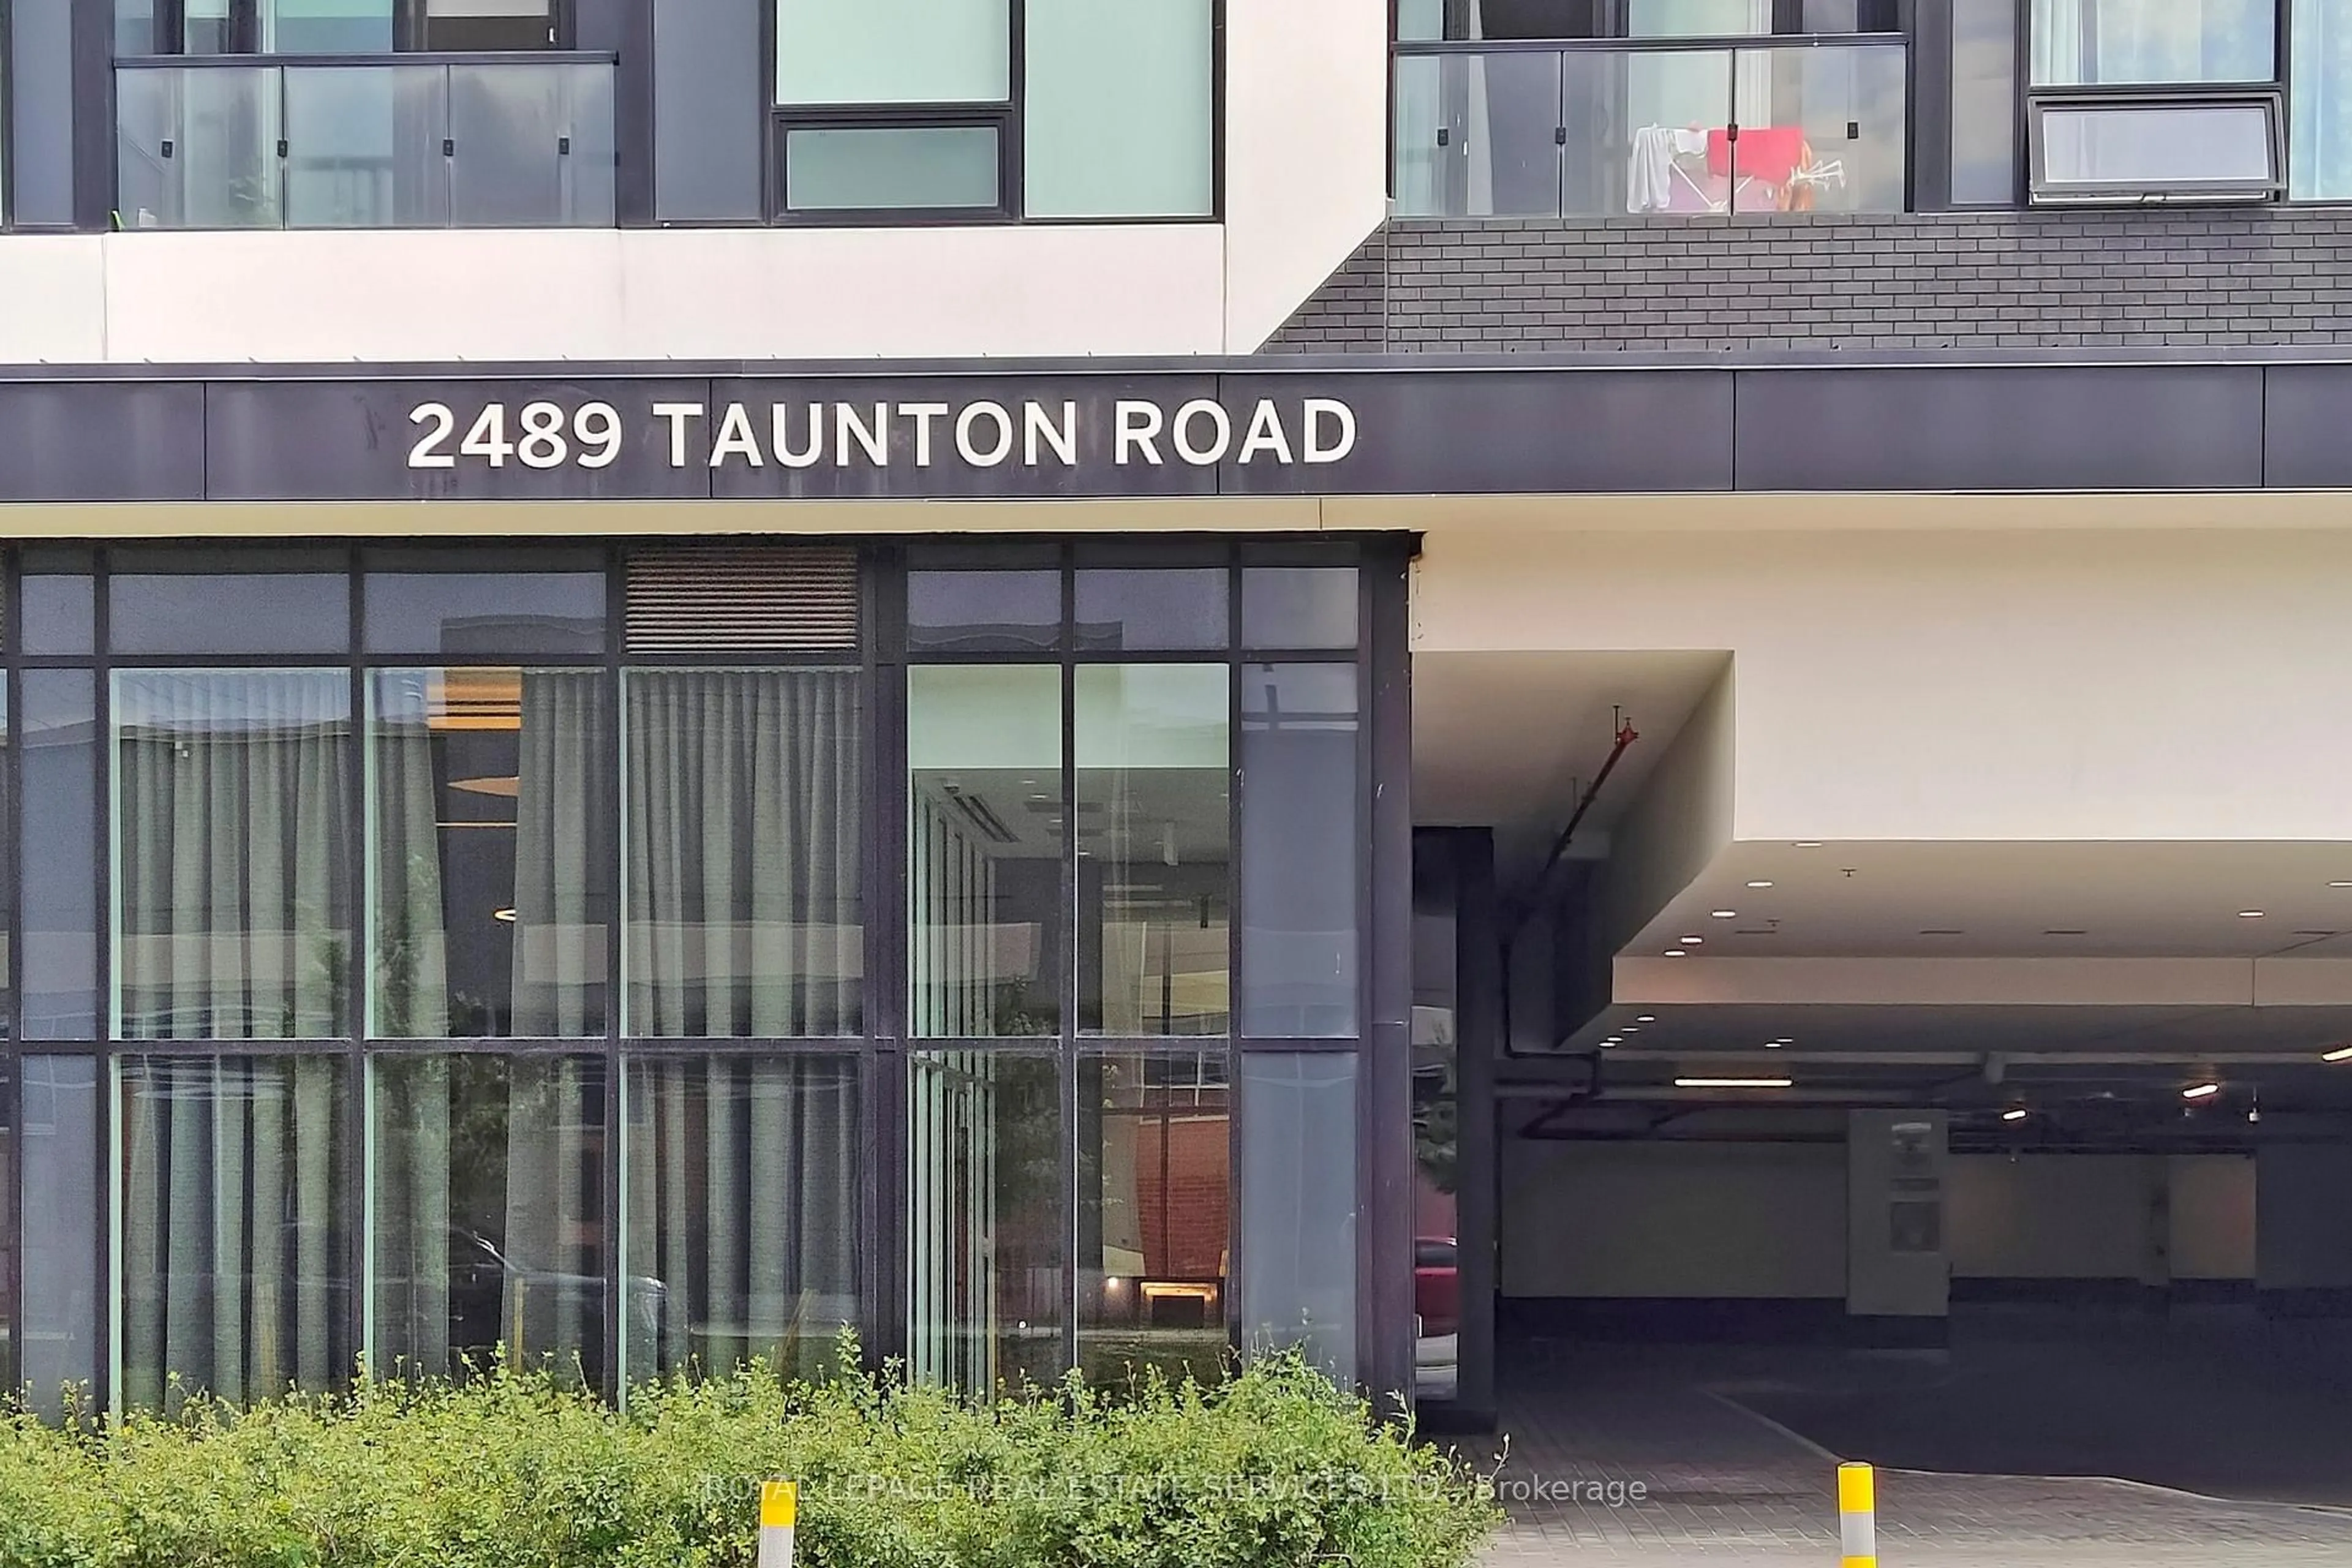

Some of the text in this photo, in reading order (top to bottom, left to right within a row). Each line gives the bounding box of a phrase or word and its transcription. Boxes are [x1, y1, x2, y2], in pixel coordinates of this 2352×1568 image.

[408, 399, 1356, 469] 2489 TAUNTON ROAD
